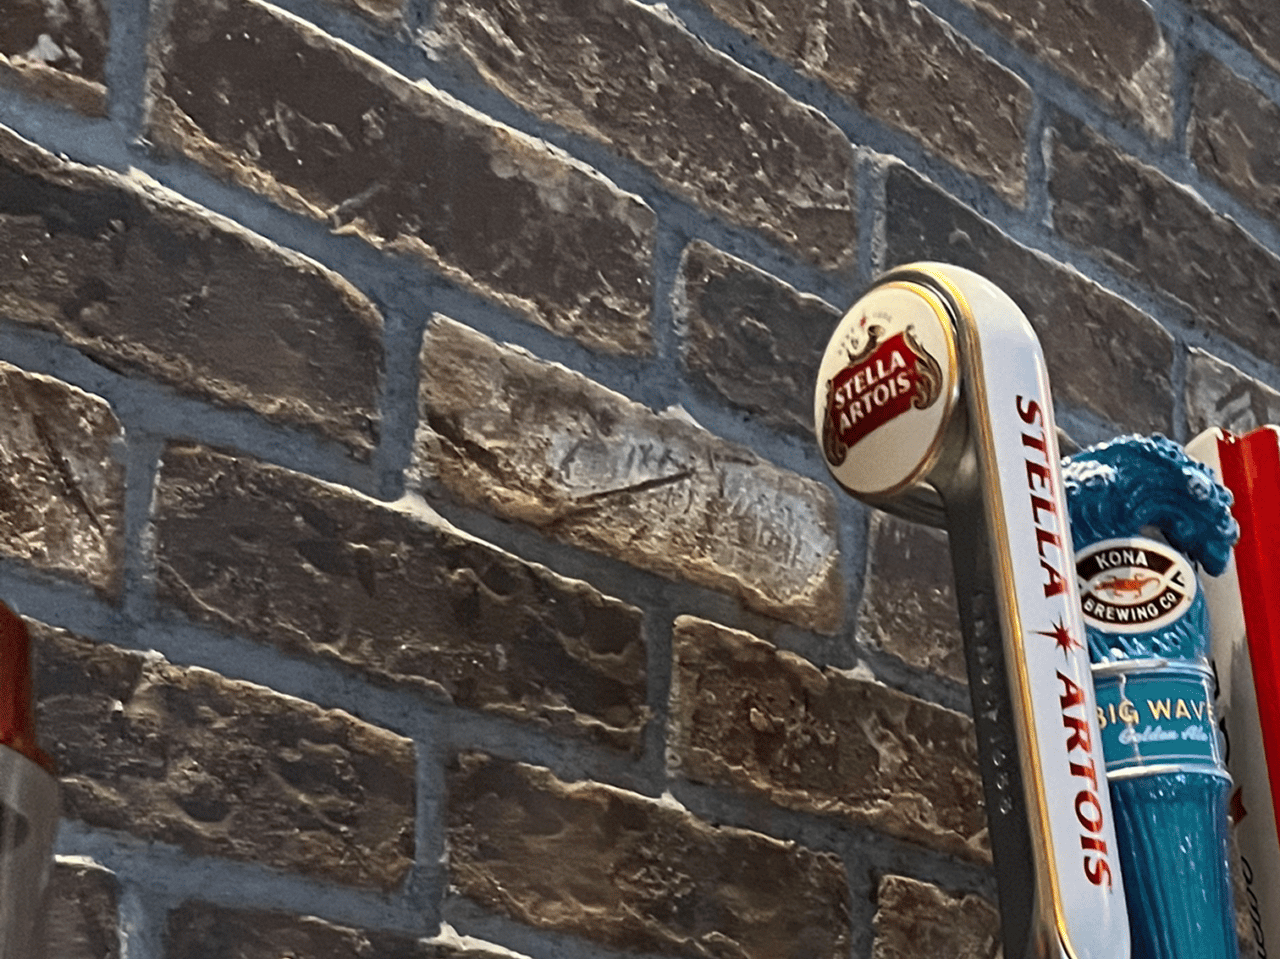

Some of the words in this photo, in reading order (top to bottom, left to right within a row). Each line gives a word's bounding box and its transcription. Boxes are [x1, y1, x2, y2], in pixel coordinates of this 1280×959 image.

[835, 350, 906, 409] STELLA
[840, 372, 911, 435] ARTOIS
[1095, 550, 1148, 570] KONA
[1083, 598, 1159, 621] BREWING
[1015, 394, 1067, 600] STELLA
[1056, 668, 1113, 895] ARTOIS
[1097, 700, 1140, 730] BIG
[1146, 698, 1211, 722] WAV
